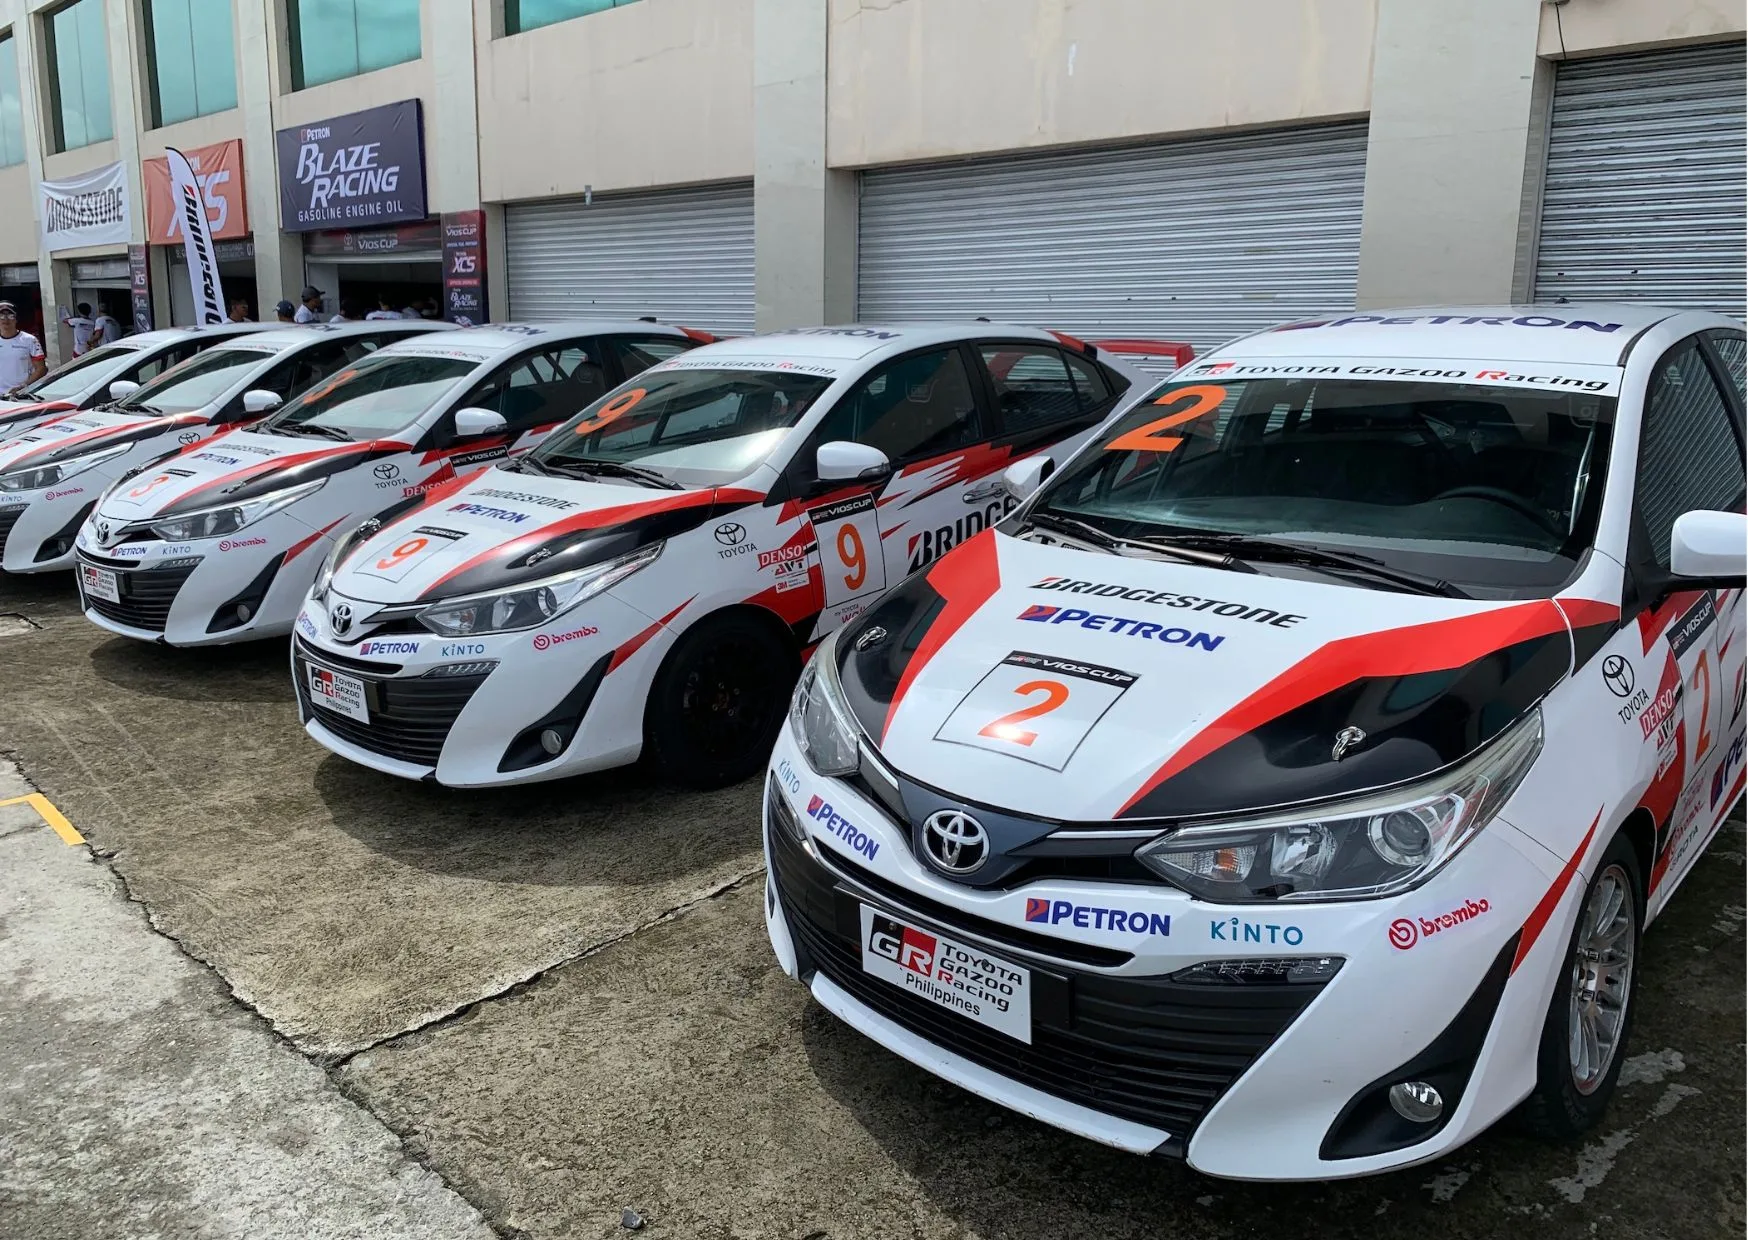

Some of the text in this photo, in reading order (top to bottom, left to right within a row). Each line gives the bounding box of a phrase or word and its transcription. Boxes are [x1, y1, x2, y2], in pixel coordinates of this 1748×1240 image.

[306, 127, 330, 141] PETRON
[296, 142, 381, 185] BLAZE
[310, 166, 400, 209] RACING
[46, 186, 123, 233] BRIDGESTONE
[298, 200, 403, 222] GASOLINE ENGINE OIL
[453, 256, 476, 273] XCS
[1329, 315, 1623, 333] PETRON
[778, 361, 836, 375] Racing
[1236, 366, 1340, 374] TOYOTA
[1349, 366, 1466, 378] GAZOO
[1475, 370, 1609, 391] Racing
[575, 387, 648, 435] 9
[1103, 384, 1226, 452] 2
[375, 478, 409, 490] TOYOTA
[470, 488, 581, 510] BRIDGESTONE
[461, 503, 531, 524] PETRON
[117, 547, 148, 556] PETRON
[232, 537, 266, 548] brembo
[376, 538, 429, 570] 9
[717, 543, 758, 560] TOYOTA
[761, 544, 802, 566] DENSO
[837, 523, 866, 590] 9
[1028, 575, 1308, 629] BRIDGESTONE
[551, 627, 598, 644] brembo
[1051, 608, 1225, 652] PETRON
[369, 642, 419, 655] PETRON
[334, 675, 362, 691] TOYOTA
[334, 683, 360, 698] GAZOO
[335, 691, 360, 709] Racing
[976, 680, 1070, 748] 2
[1618, 687, 1650, 725] TOYOTA
[1641, 689, 1673, 736] DENSO
[1693, 649, 1711, 767] 2
[818, 802, 880, 861] PETRON
[1053, 900, 1170, 937] PETRON
[1418, 898, 1490, 937] brembo
[939, 956, 1014, 996] GAZOO
[941, 943, 1023, 986] TOYOTA
[905, 973, 981, 1016] Philippines
[937, 970, 1010, 1012] Racing
